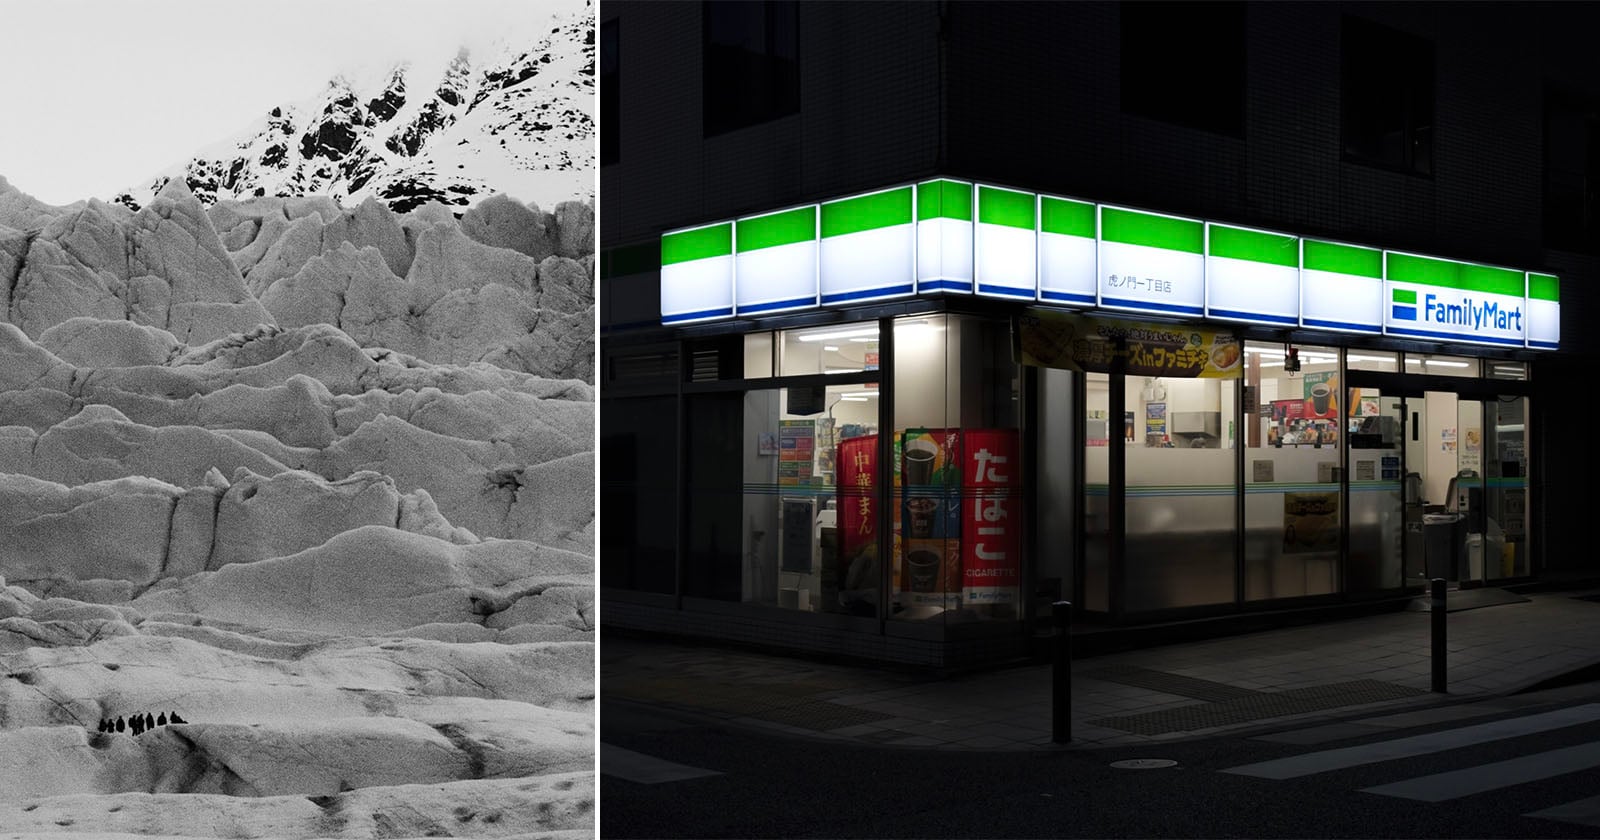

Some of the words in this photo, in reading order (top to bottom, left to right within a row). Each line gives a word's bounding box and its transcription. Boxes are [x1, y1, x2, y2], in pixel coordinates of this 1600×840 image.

[1108, 274, 1172, 293] 虎ノ門一丁目店
[1425, 293, 1522, 331] FamilyMart
[854, 450, 873, 536] 中華まん
[973, 447, 1009, 561] たばこ
[966, 568, 1016, 577] CIGARETTE
